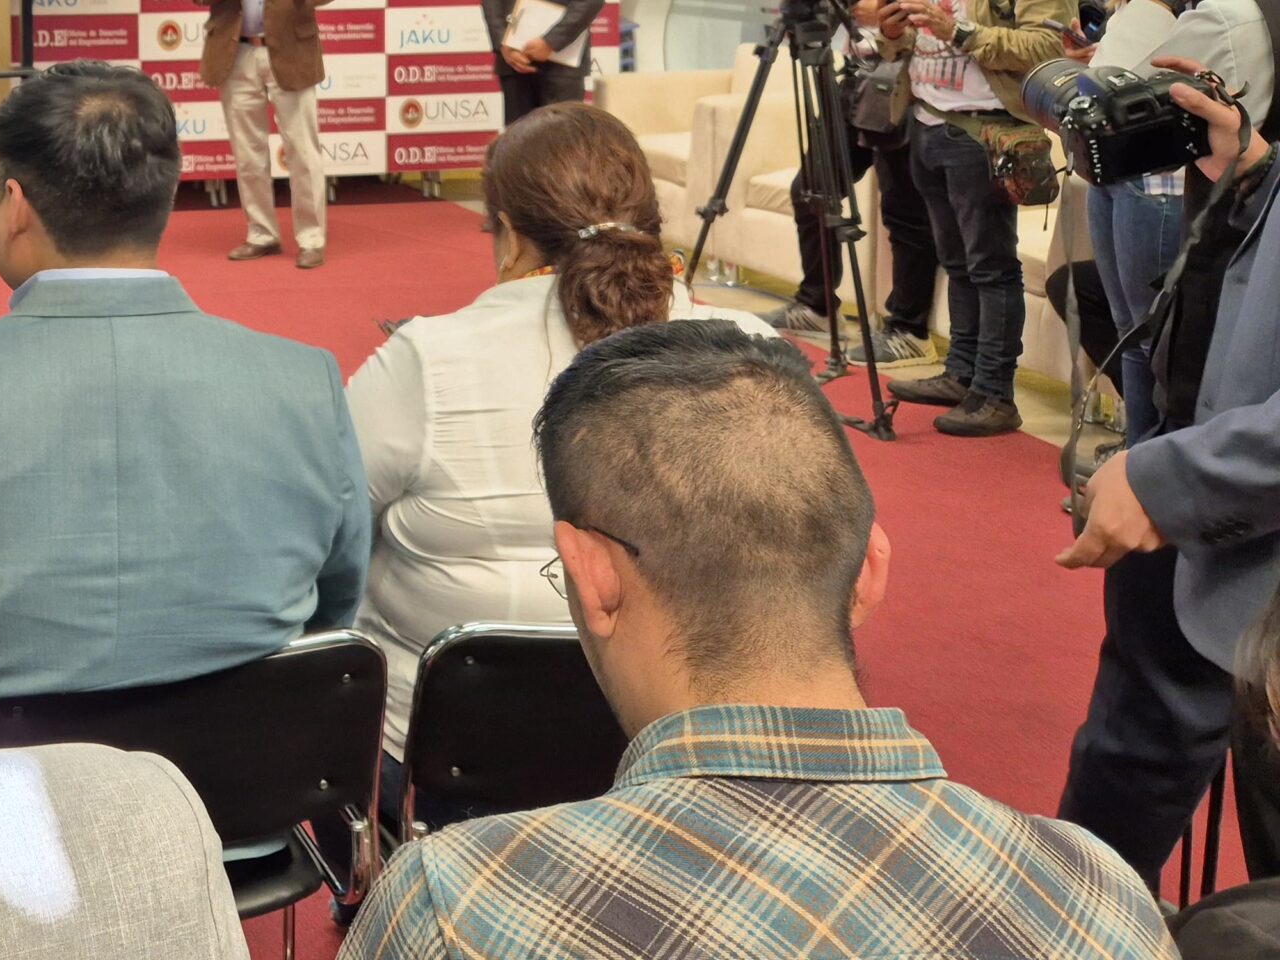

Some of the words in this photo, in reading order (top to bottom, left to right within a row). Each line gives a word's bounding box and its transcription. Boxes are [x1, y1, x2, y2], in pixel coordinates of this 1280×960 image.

[400, 28, 450, 48] JAKU
[425, 100, 489, 120] UNSA
[320, 142, 368, 161] NSA
